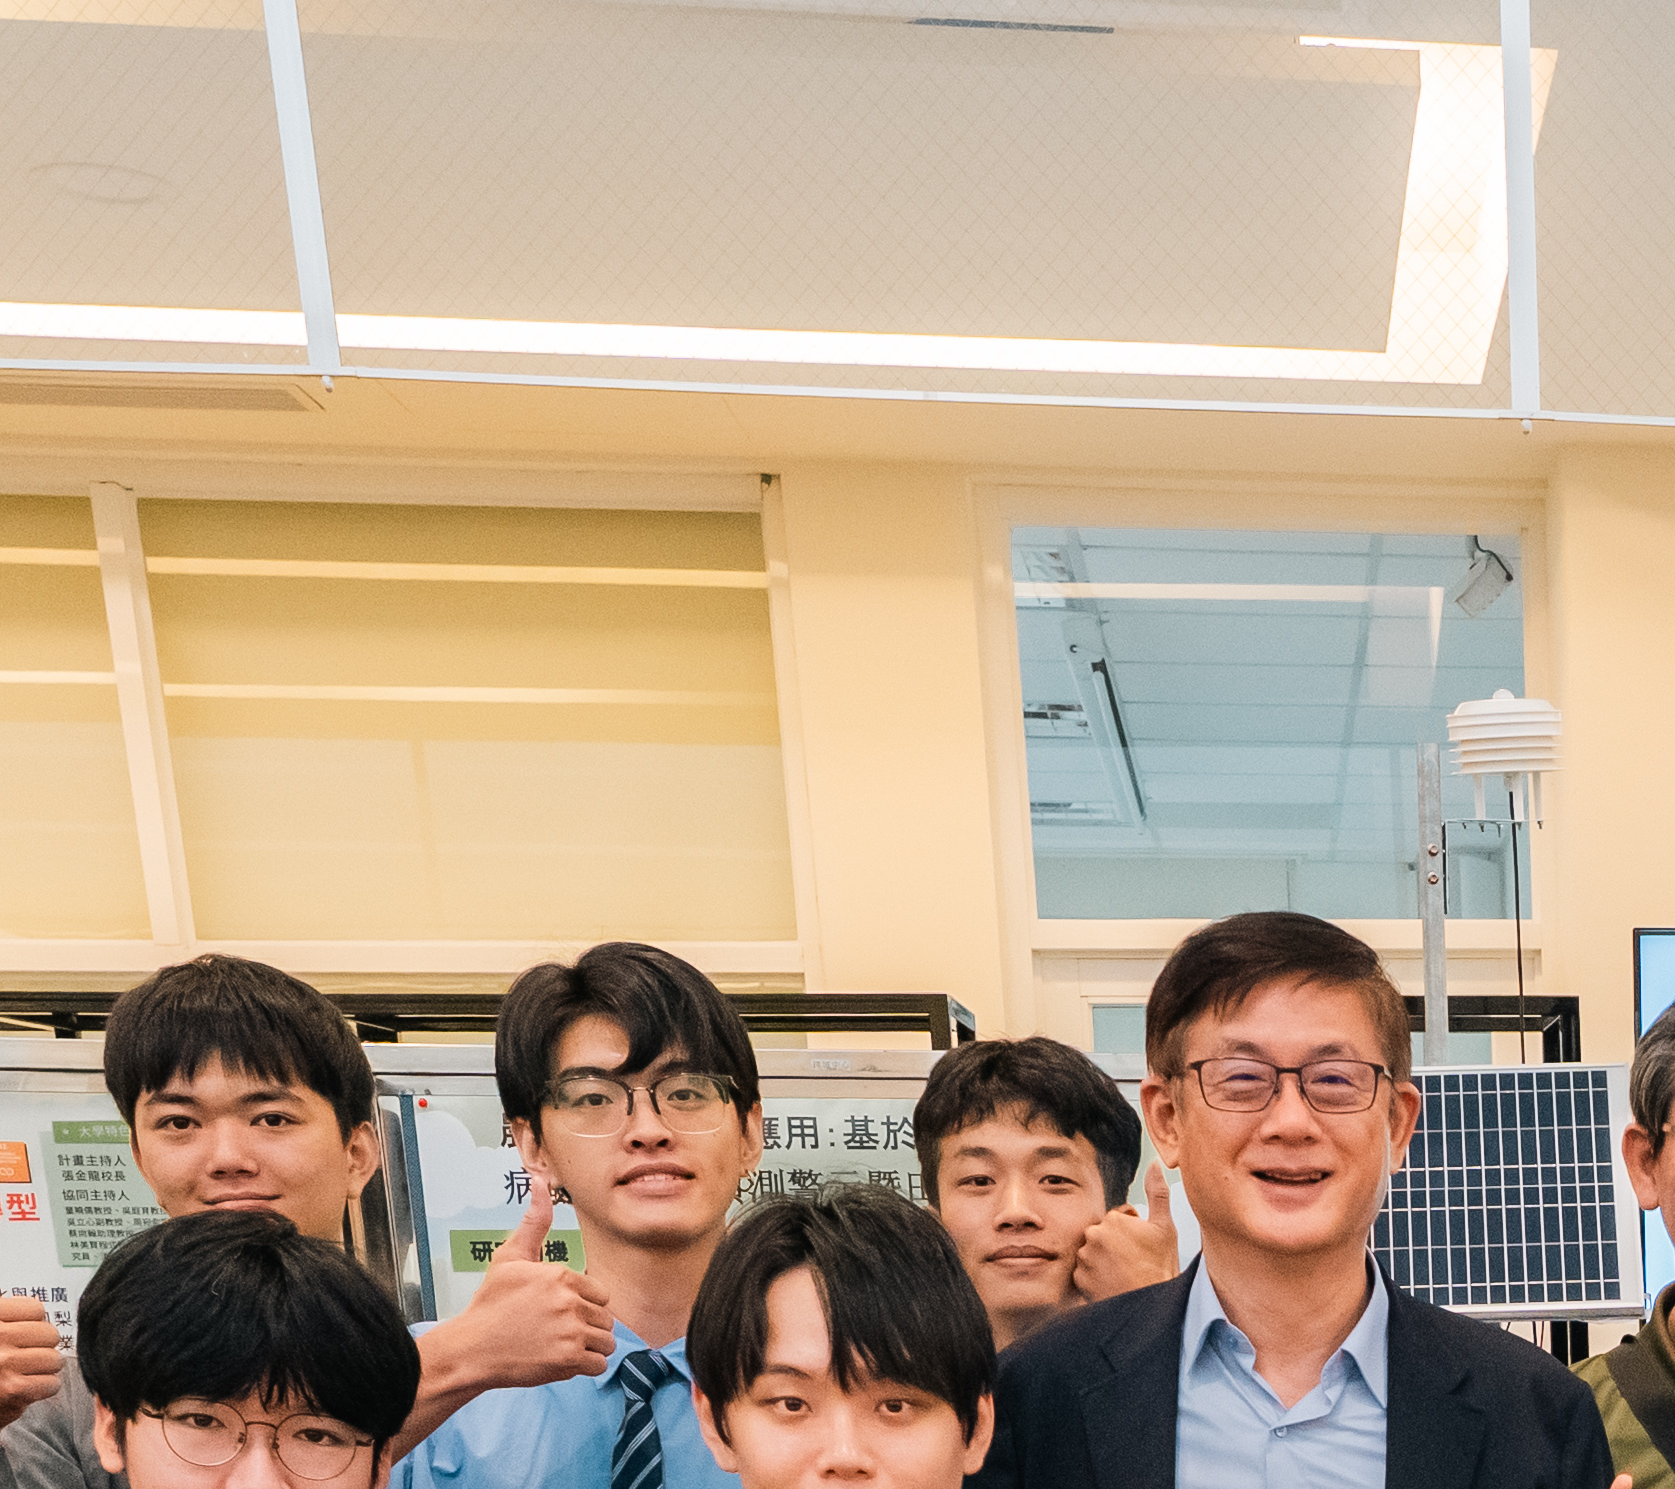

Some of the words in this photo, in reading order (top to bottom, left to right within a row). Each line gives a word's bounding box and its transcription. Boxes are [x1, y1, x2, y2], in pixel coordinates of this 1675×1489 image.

[57, 1154, 126, 1167] 計畫主持人
[62, 1190, 130, 1201] 協同主持人
[469, 1238, 570, 1263] 研機
